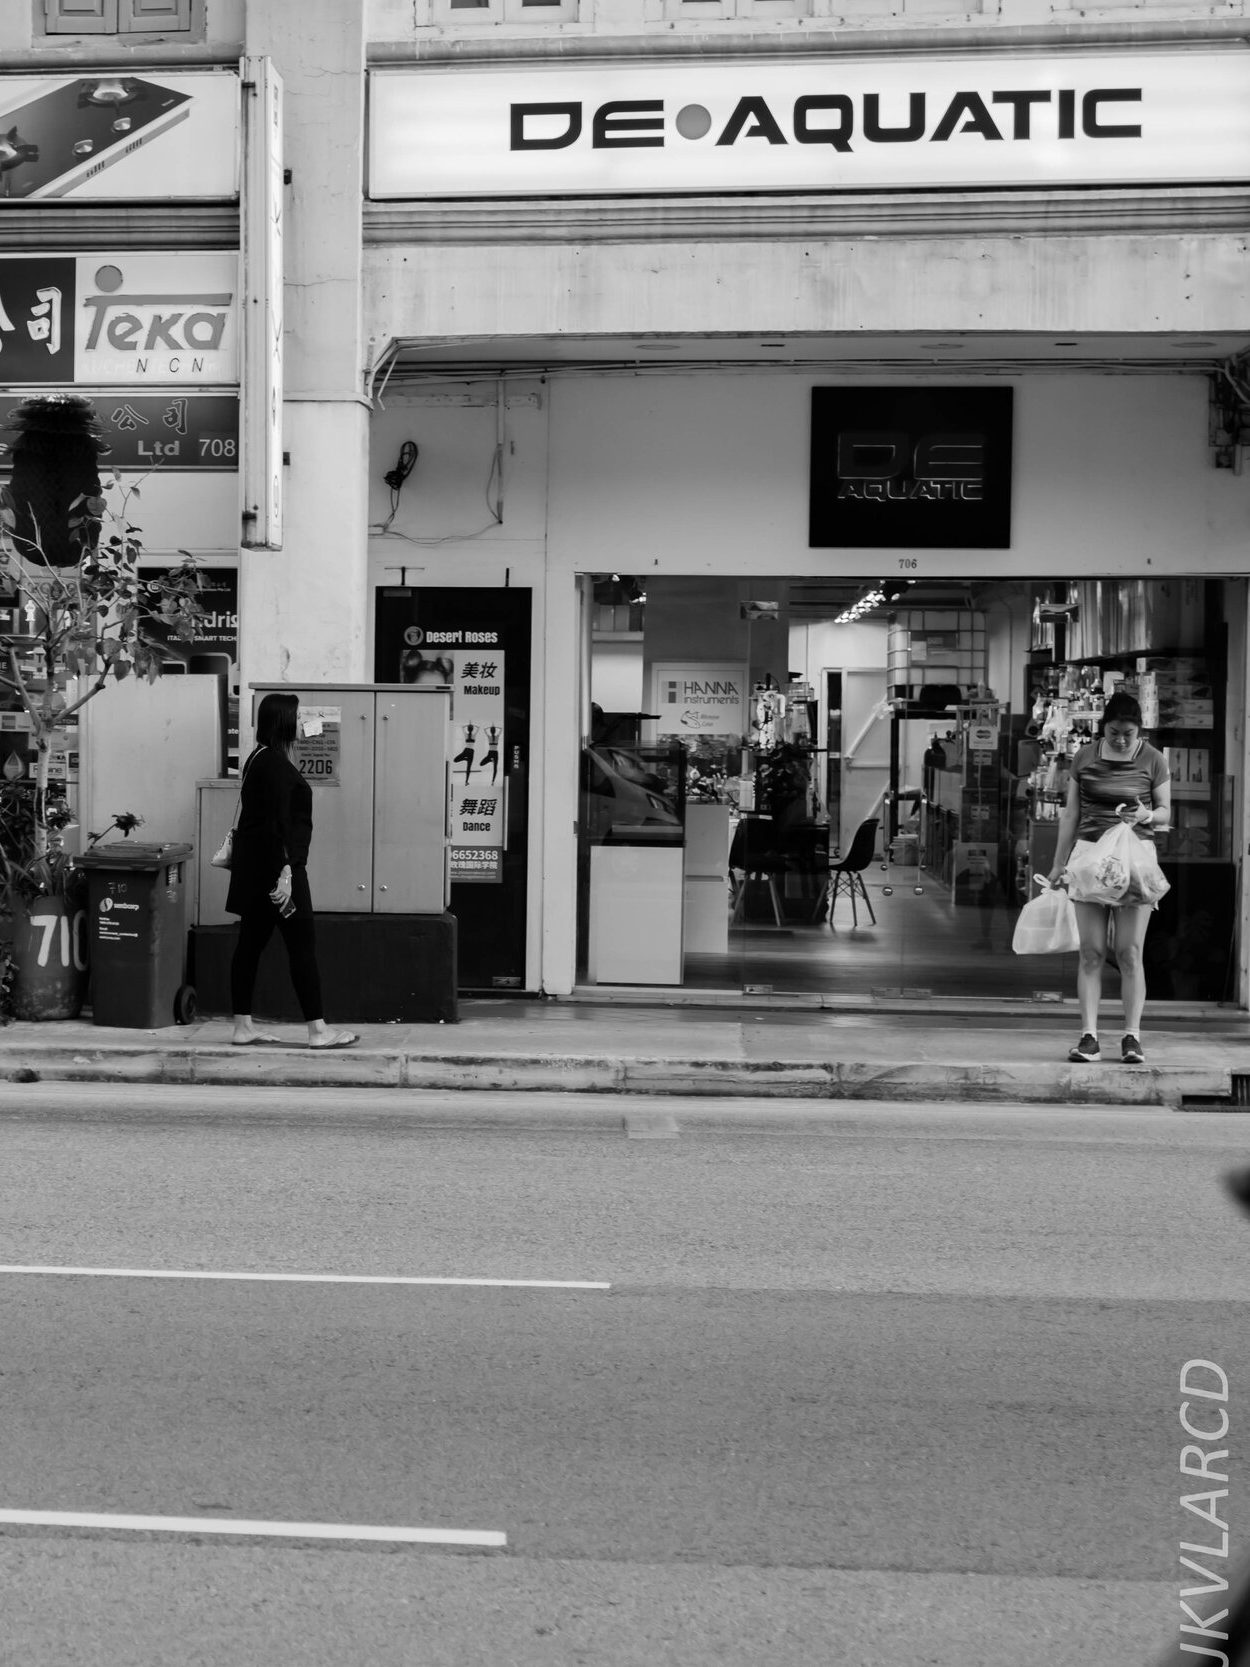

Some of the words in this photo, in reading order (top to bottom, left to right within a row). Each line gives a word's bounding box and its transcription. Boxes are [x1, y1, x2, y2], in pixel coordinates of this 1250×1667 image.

[510, 99, 664, 151] DE
[715, 88, 1143, 153] AQUATIC
[137, 440, 180, 456] Ltd
[199, 439, 236, 457] 708
[899, 558, 918, 569] 706
[426, 630, 462, 643] Desert
[465, 631, 498, 643] Roses
[461, 661, 498, 679] 美妆
[463, 684, 500, 696] Makeup
[684, 681, 739, 695] HANNA
[299, 759, 333, 775] 2206
[459, 798, 498, 816] 舞蹈
[462, 822, 491, 832] Dance
[450, 850, 499, 860] 6652368
